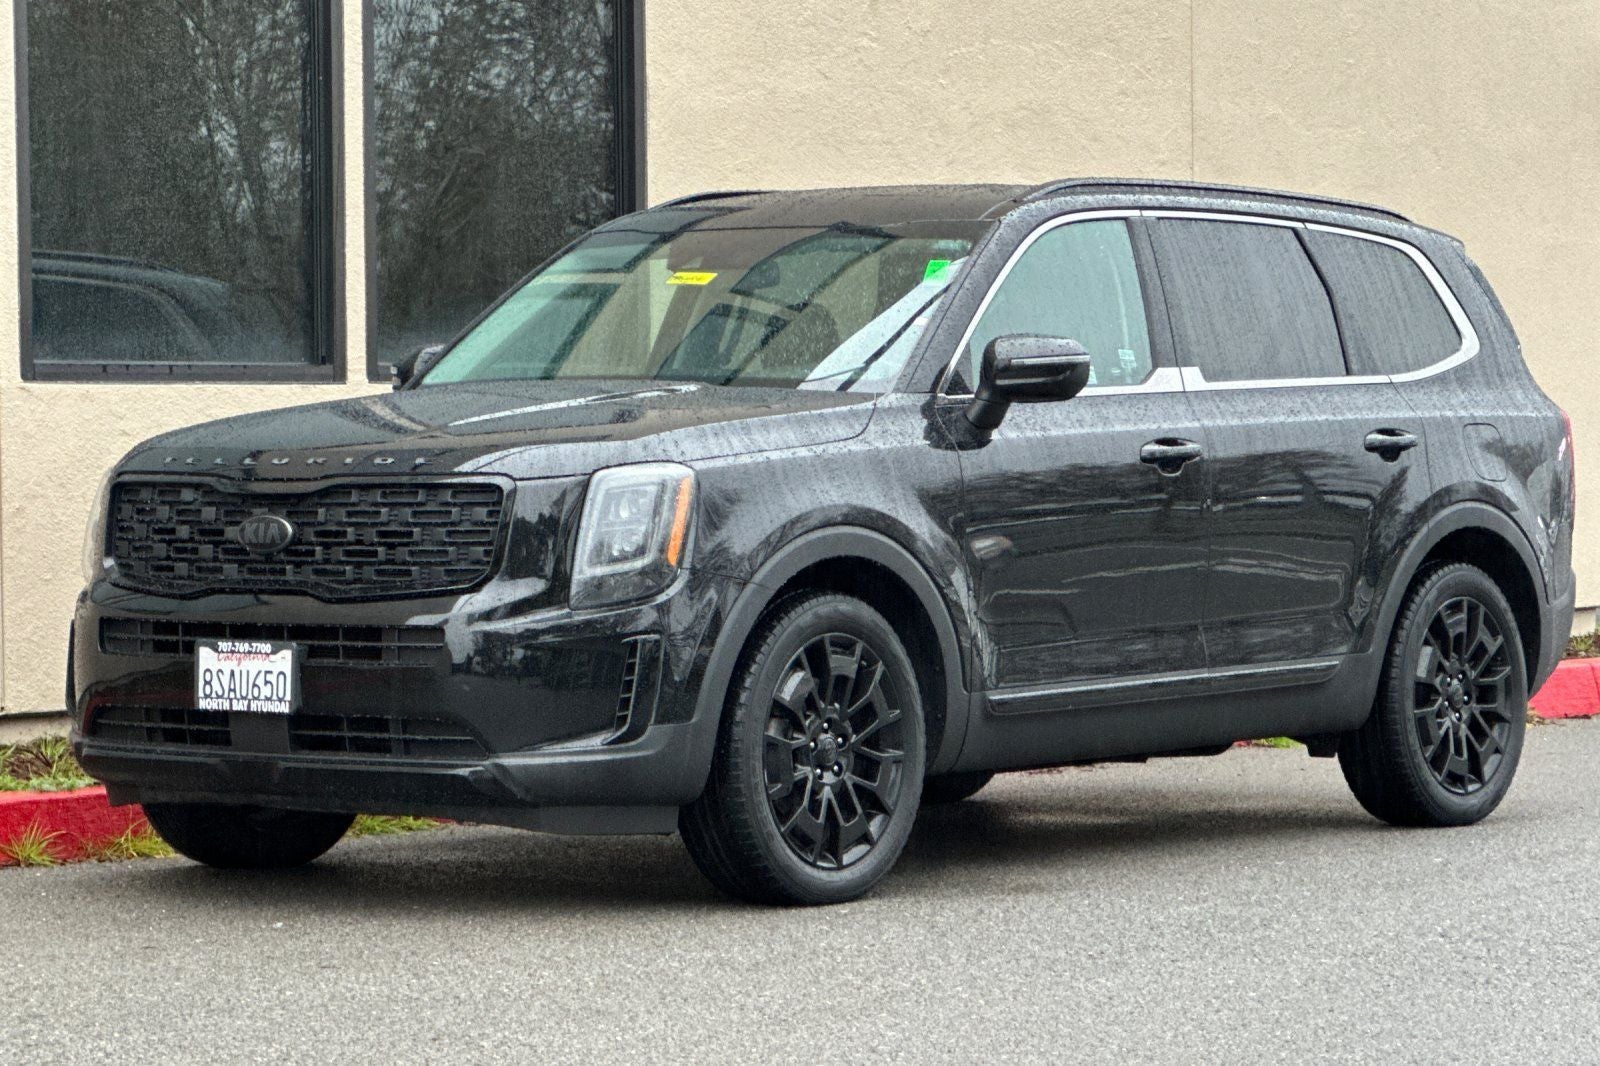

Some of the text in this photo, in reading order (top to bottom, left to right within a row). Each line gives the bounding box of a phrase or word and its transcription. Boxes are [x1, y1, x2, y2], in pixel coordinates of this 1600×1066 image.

[162, 457, 432, 466] TELLURIDE
[244, 522, 281, 544] KIA
[217, 641, 272, 654] 707-769-7700
[202, 667, 287, 701] 8SAU650
[199, 698, 290, 714] NORTH BAY HYUNDAI
